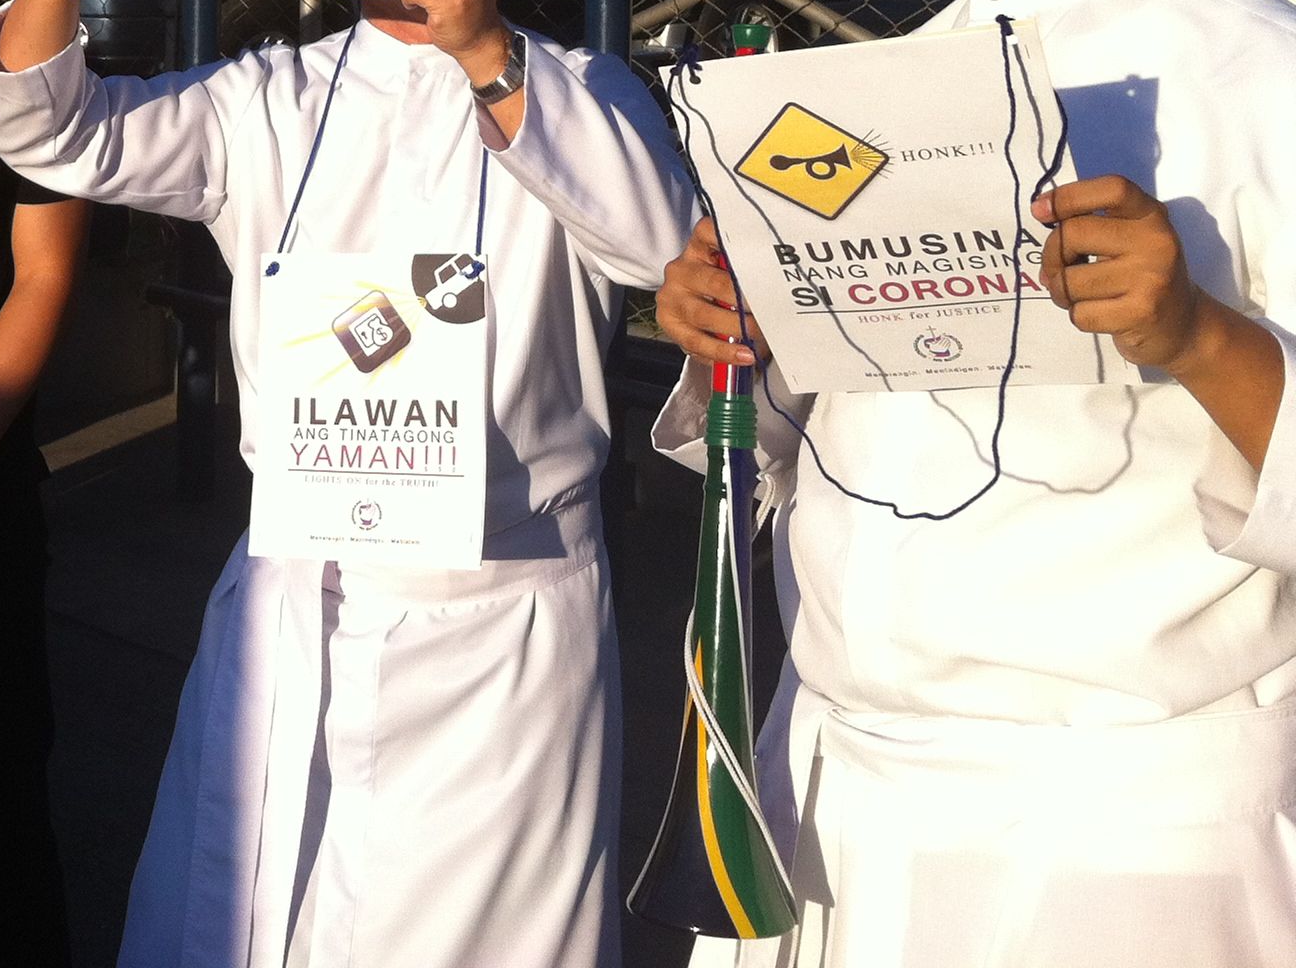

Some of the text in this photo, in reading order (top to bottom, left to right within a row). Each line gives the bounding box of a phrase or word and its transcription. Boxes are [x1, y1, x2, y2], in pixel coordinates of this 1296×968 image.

[900, 142, 995, 162] HONK!!!
[773, 228, 1042, 266] BUMUSINA
[783, 250, 1044, 282] NANG MAGISING
[791, 271, 1049, 308] SI CORONA
[857, 305, 1003, 324] HONK for JUSTICE
[293, 397, 458, 428] ILAWAN
[294, 427, 454, 444] ANG TINATAGONG
[290, 443, 456, 472] YAMAN!!!
